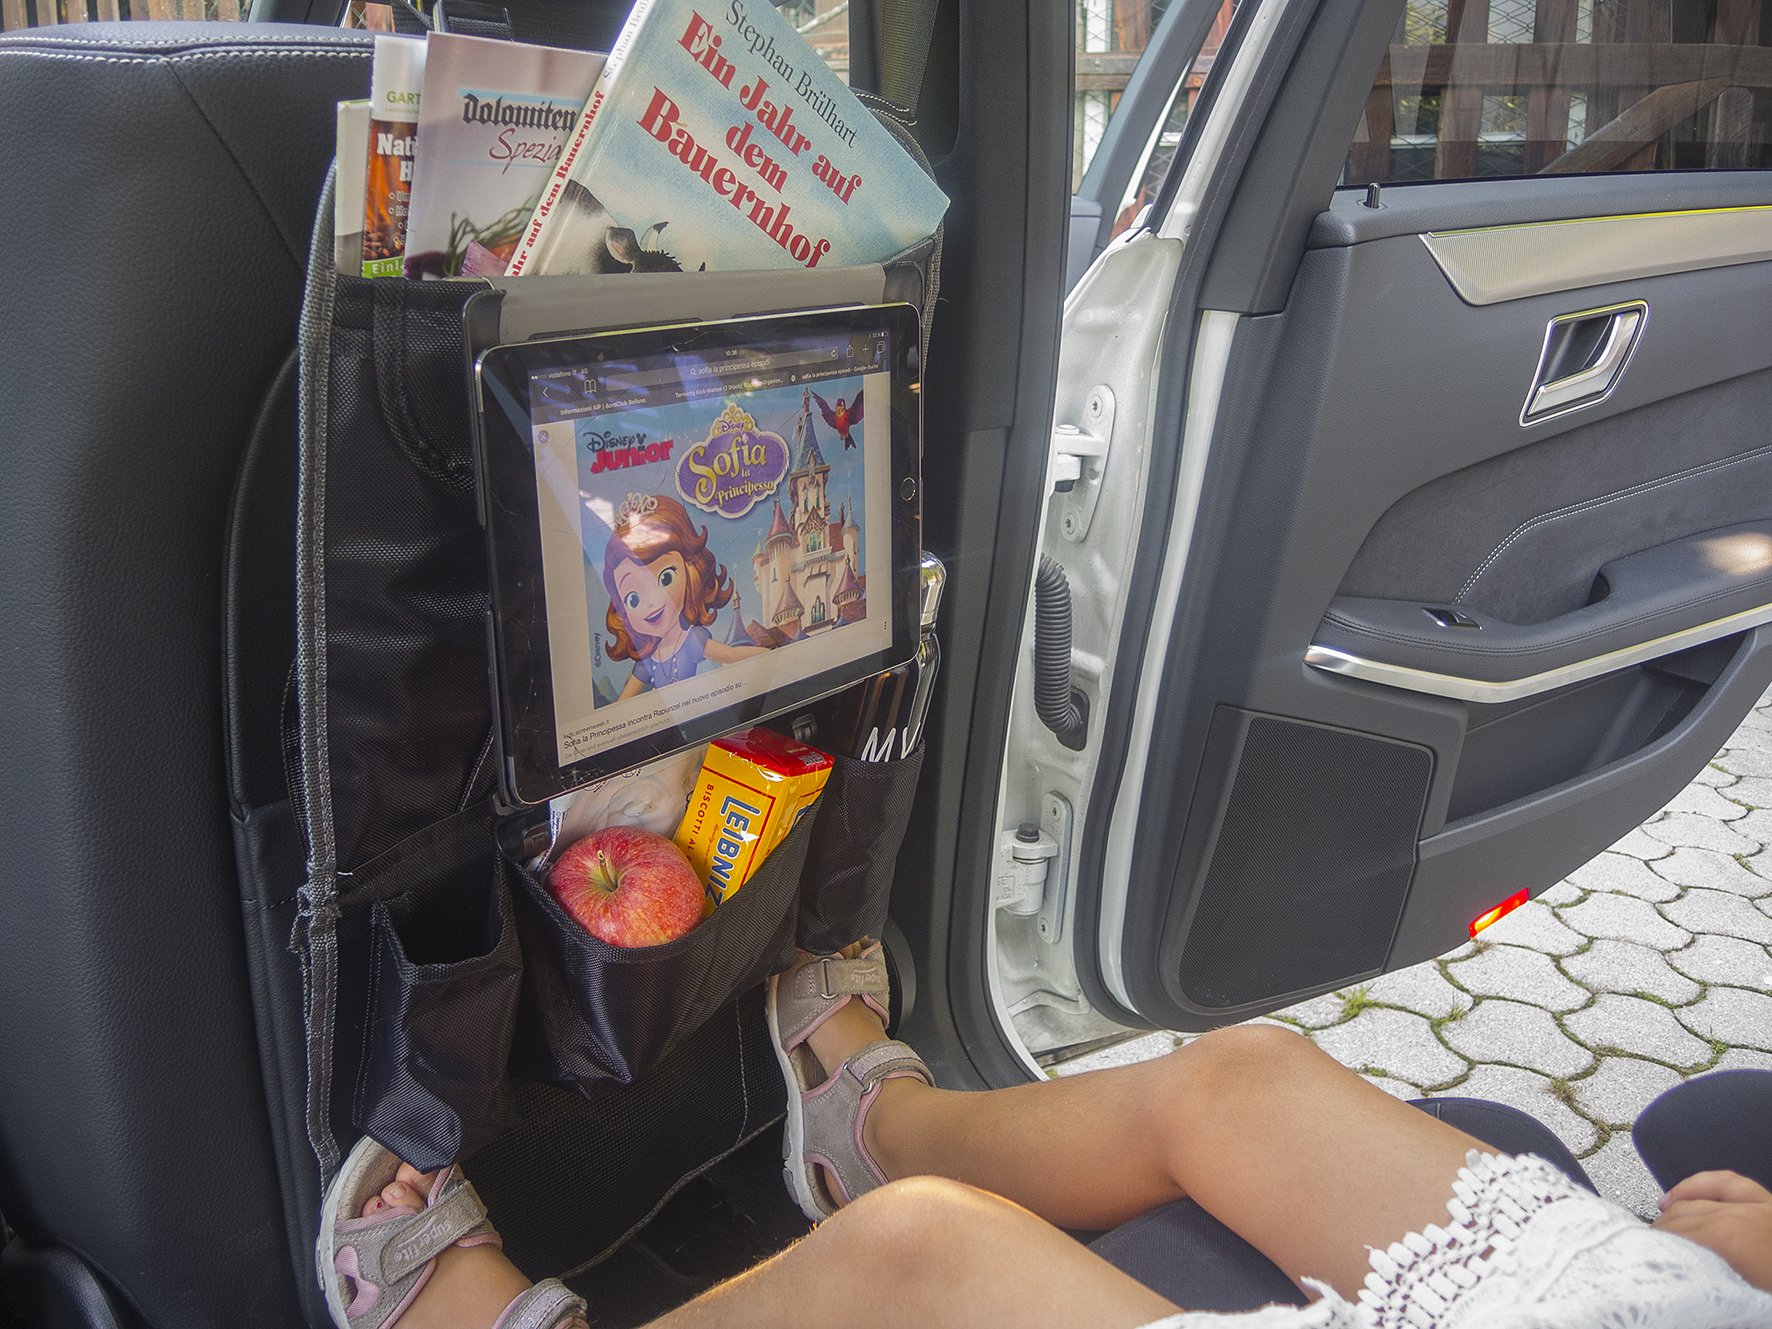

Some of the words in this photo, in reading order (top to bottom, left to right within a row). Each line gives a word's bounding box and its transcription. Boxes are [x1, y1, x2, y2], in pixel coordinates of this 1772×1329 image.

[725, 0, 795, 84] Stephan
[793, 69, 858, 149] Brülhart
[462, 93, 577, 132] Dolomiten
[677, 9, 737, 91] Ein
[738, 75, 812, 158] Jahr
[811, 154, 862, 206] auf
[526, 218, 543, 248] auf
[540, 183, 561, 218] dem
[555, 91, 605, 180] Bauernhof
[636, 85, 831, 269] Bauernhof
[725, 121, 789, 194] dem
[719, 360, 750, 373] principessa
[560, 406, 592, 415] Informazioni
[720, 420, 745, 432] Disney
[688, 434, 768, 505] Sofia
[715, 480, 774, 508] Principessa
[741, 467, 750, 478] la
[581, 735, 589, 743] la
[589, 722, 627, 740] Principessa
[627, 713, 653, 727] incontra
[653, 702, 681, 718] Rapunzel
[681, 698, 691, 709] nel
[691, 692, 710, 704] nuovo
[710, 684, 734, 699] episodio
[691, 783, 714, 835] BISCOTTI
[704, 795, 762, 907] LEIBNIZ
